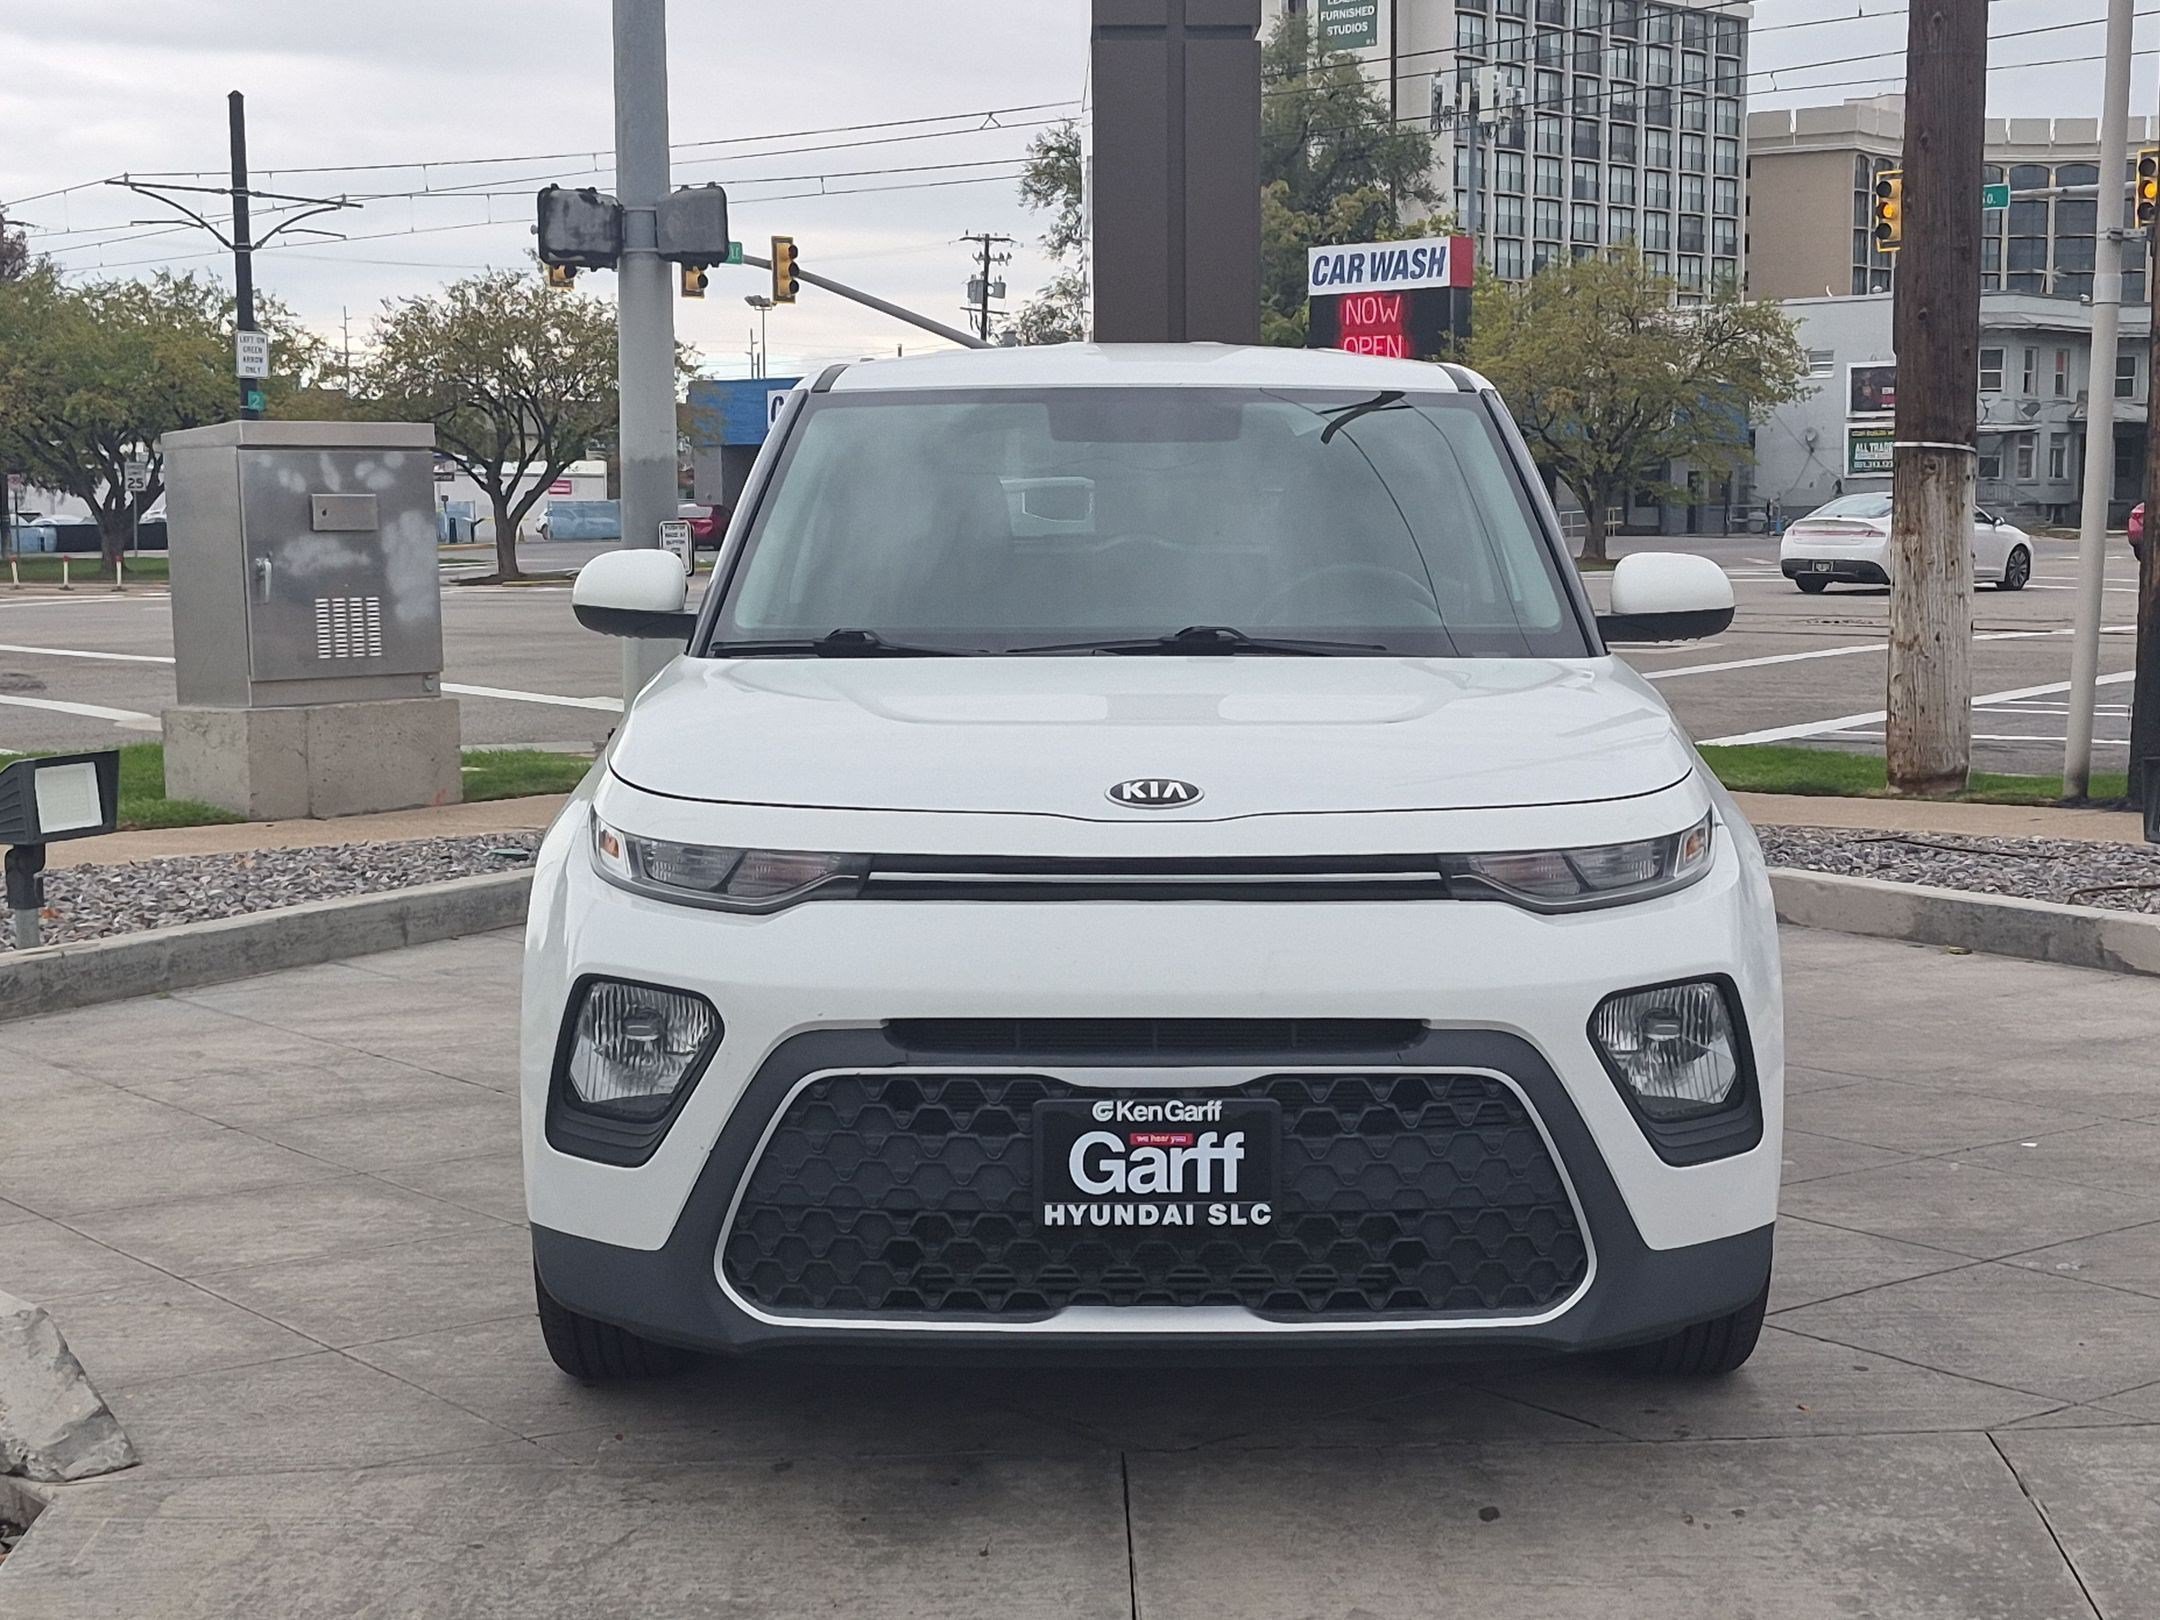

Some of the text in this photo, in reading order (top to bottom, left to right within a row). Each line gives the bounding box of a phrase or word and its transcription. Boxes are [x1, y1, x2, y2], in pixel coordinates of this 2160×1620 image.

[1320, 5, 1375, 21] FURNISHED
[1327, 21, 1368, 36] STUDIOS
[1312, 246, 1447, 286] CAR WASH
[1346, 296, 1400, 325] NOW
[1343, 335, 1402, 358] OPEN
[128, 478, 144, 488] 25
[1122, 781, 1188, 799] KIA
[1150, 1134, 1169, 1142] hear
[1069, 1131, 1244, 1195] Garff
[1044, 1203, 1272, 1226] HYUNDAI SLC
